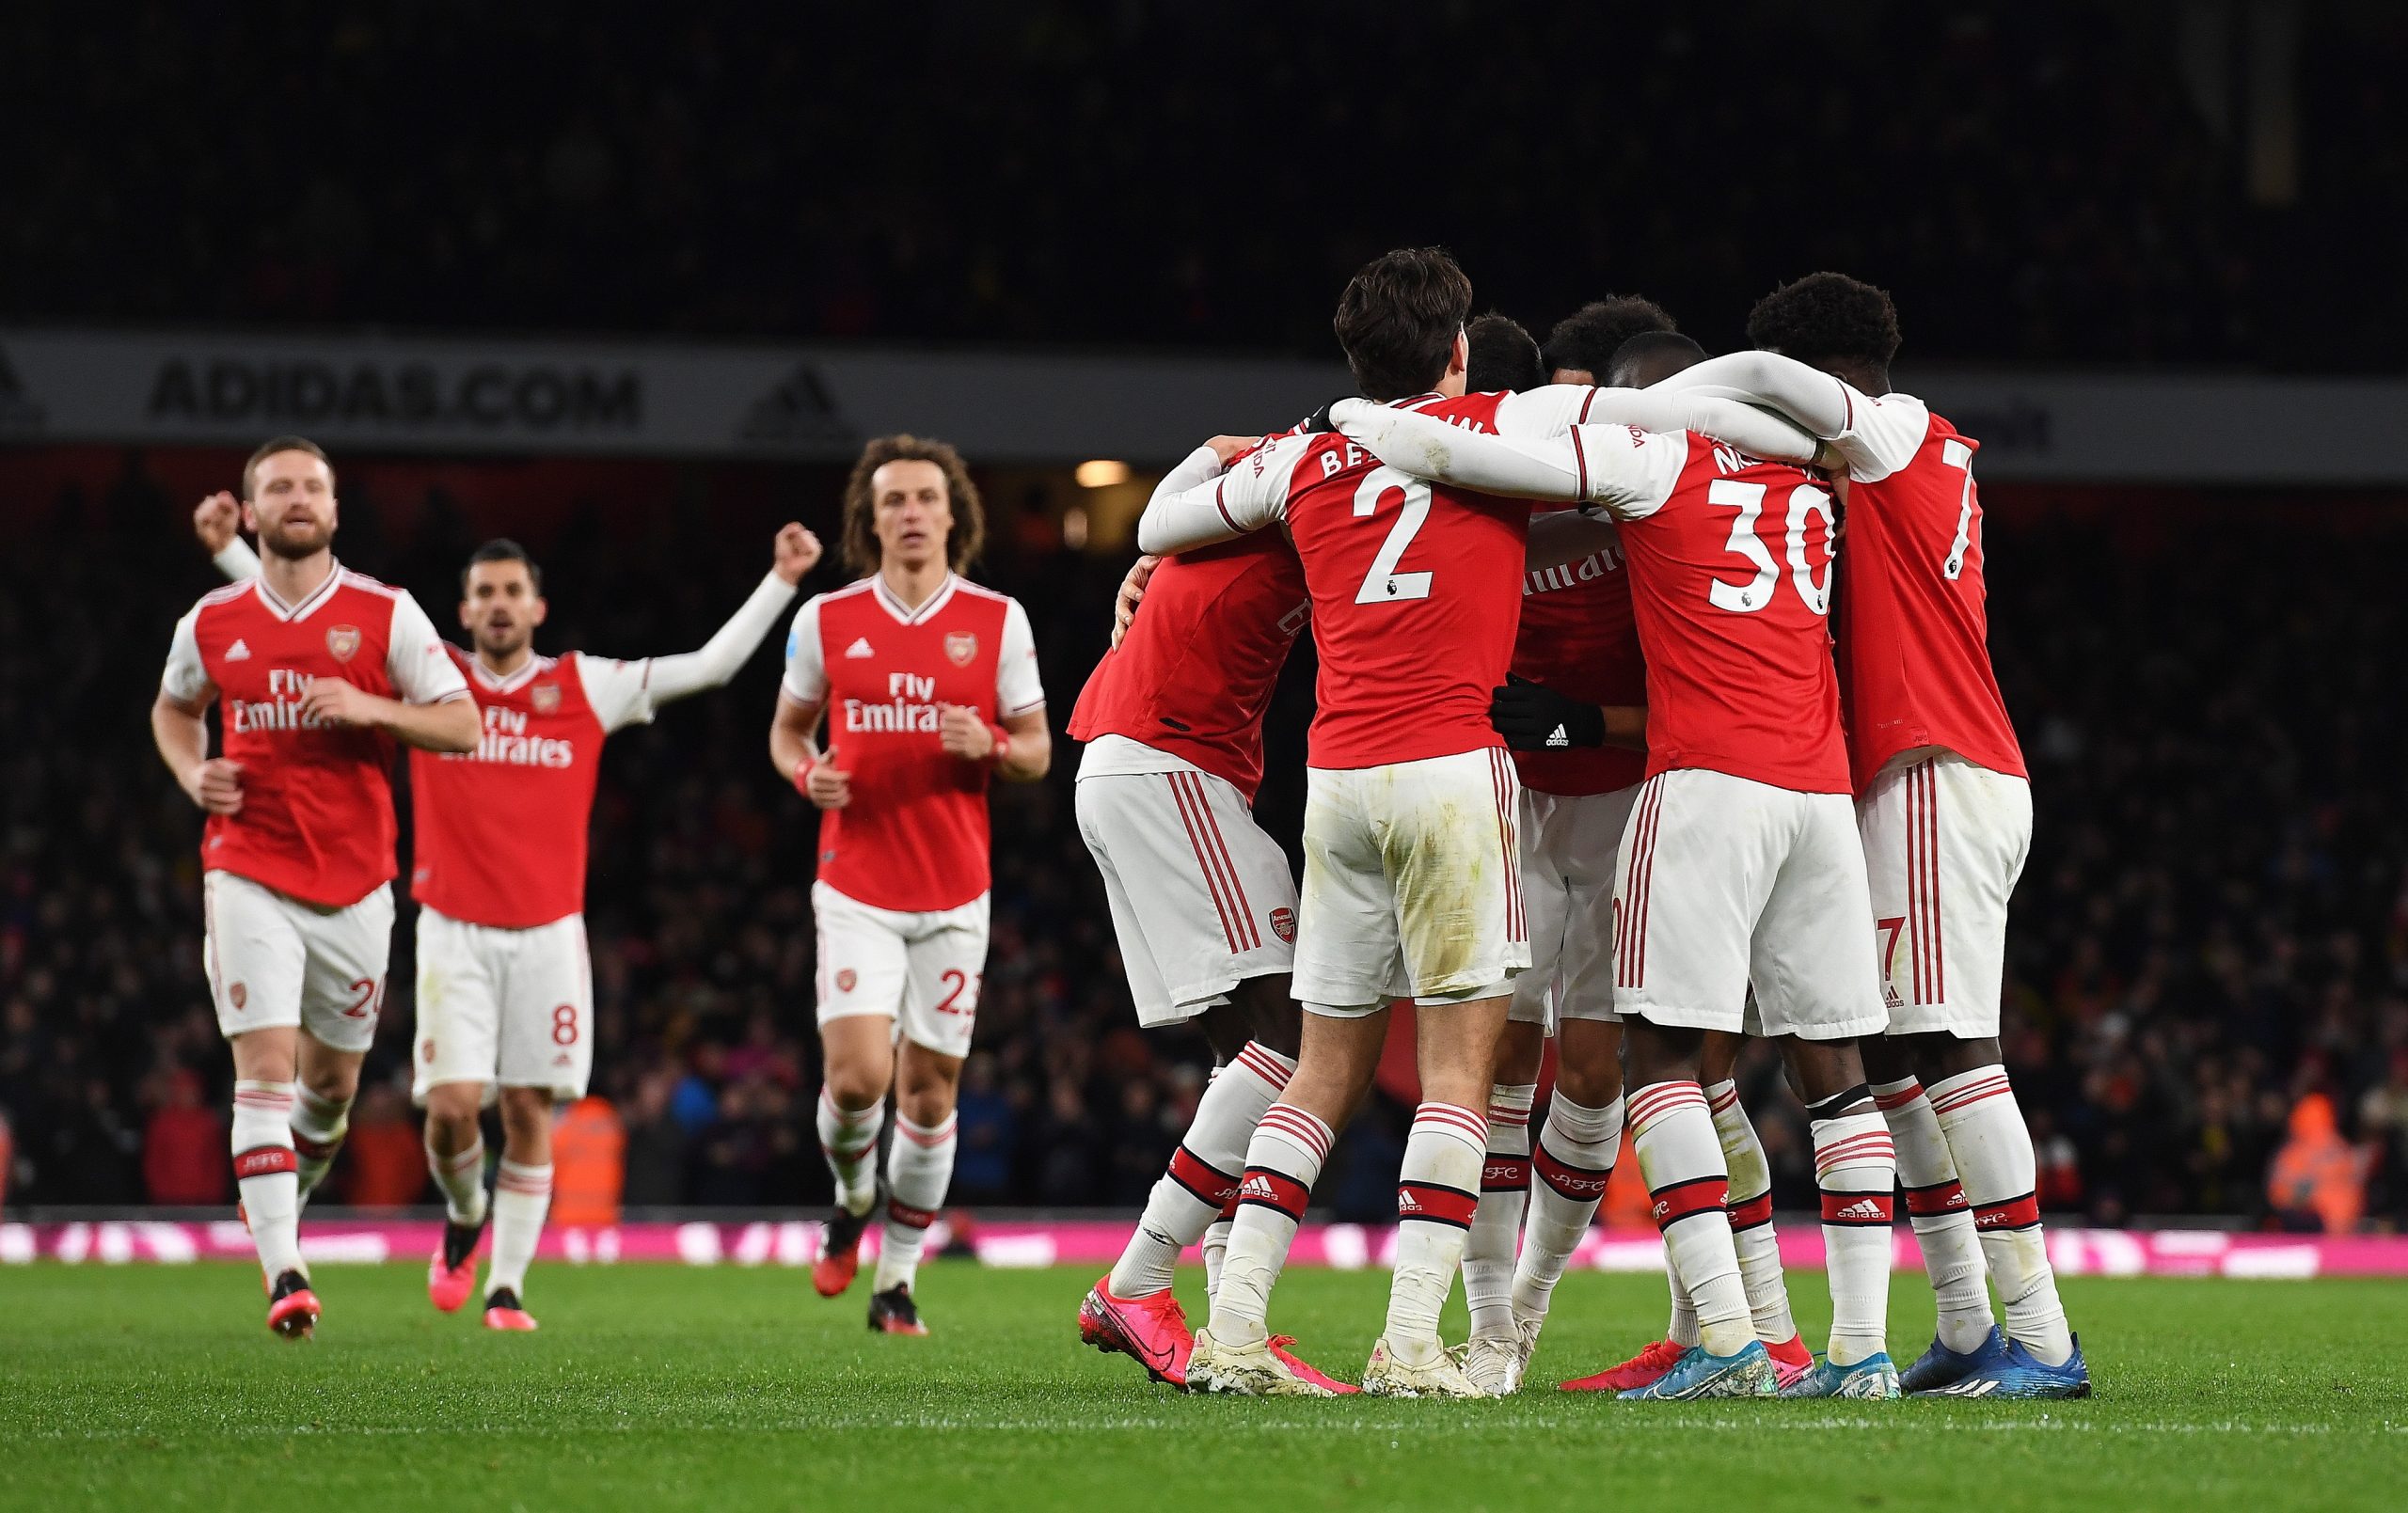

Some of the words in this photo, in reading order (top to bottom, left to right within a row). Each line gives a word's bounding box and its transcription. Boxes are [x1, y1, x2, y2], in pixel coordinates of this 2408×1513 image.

[149, 358, 643, 429] ADIDAS.COM
[1353, 465, 1434, 605] 2
[1941, 438, 1973, 581] 7
[1708, 478, 1836, 616] 30
[889, 671, 936, 702] Fly
[484, 705, 528, 736] Fly
[1545, 737, 1569, 746] adidas
[1877, 916, 1907, 982] 7
[552, 1004, 578, 1046] 8
